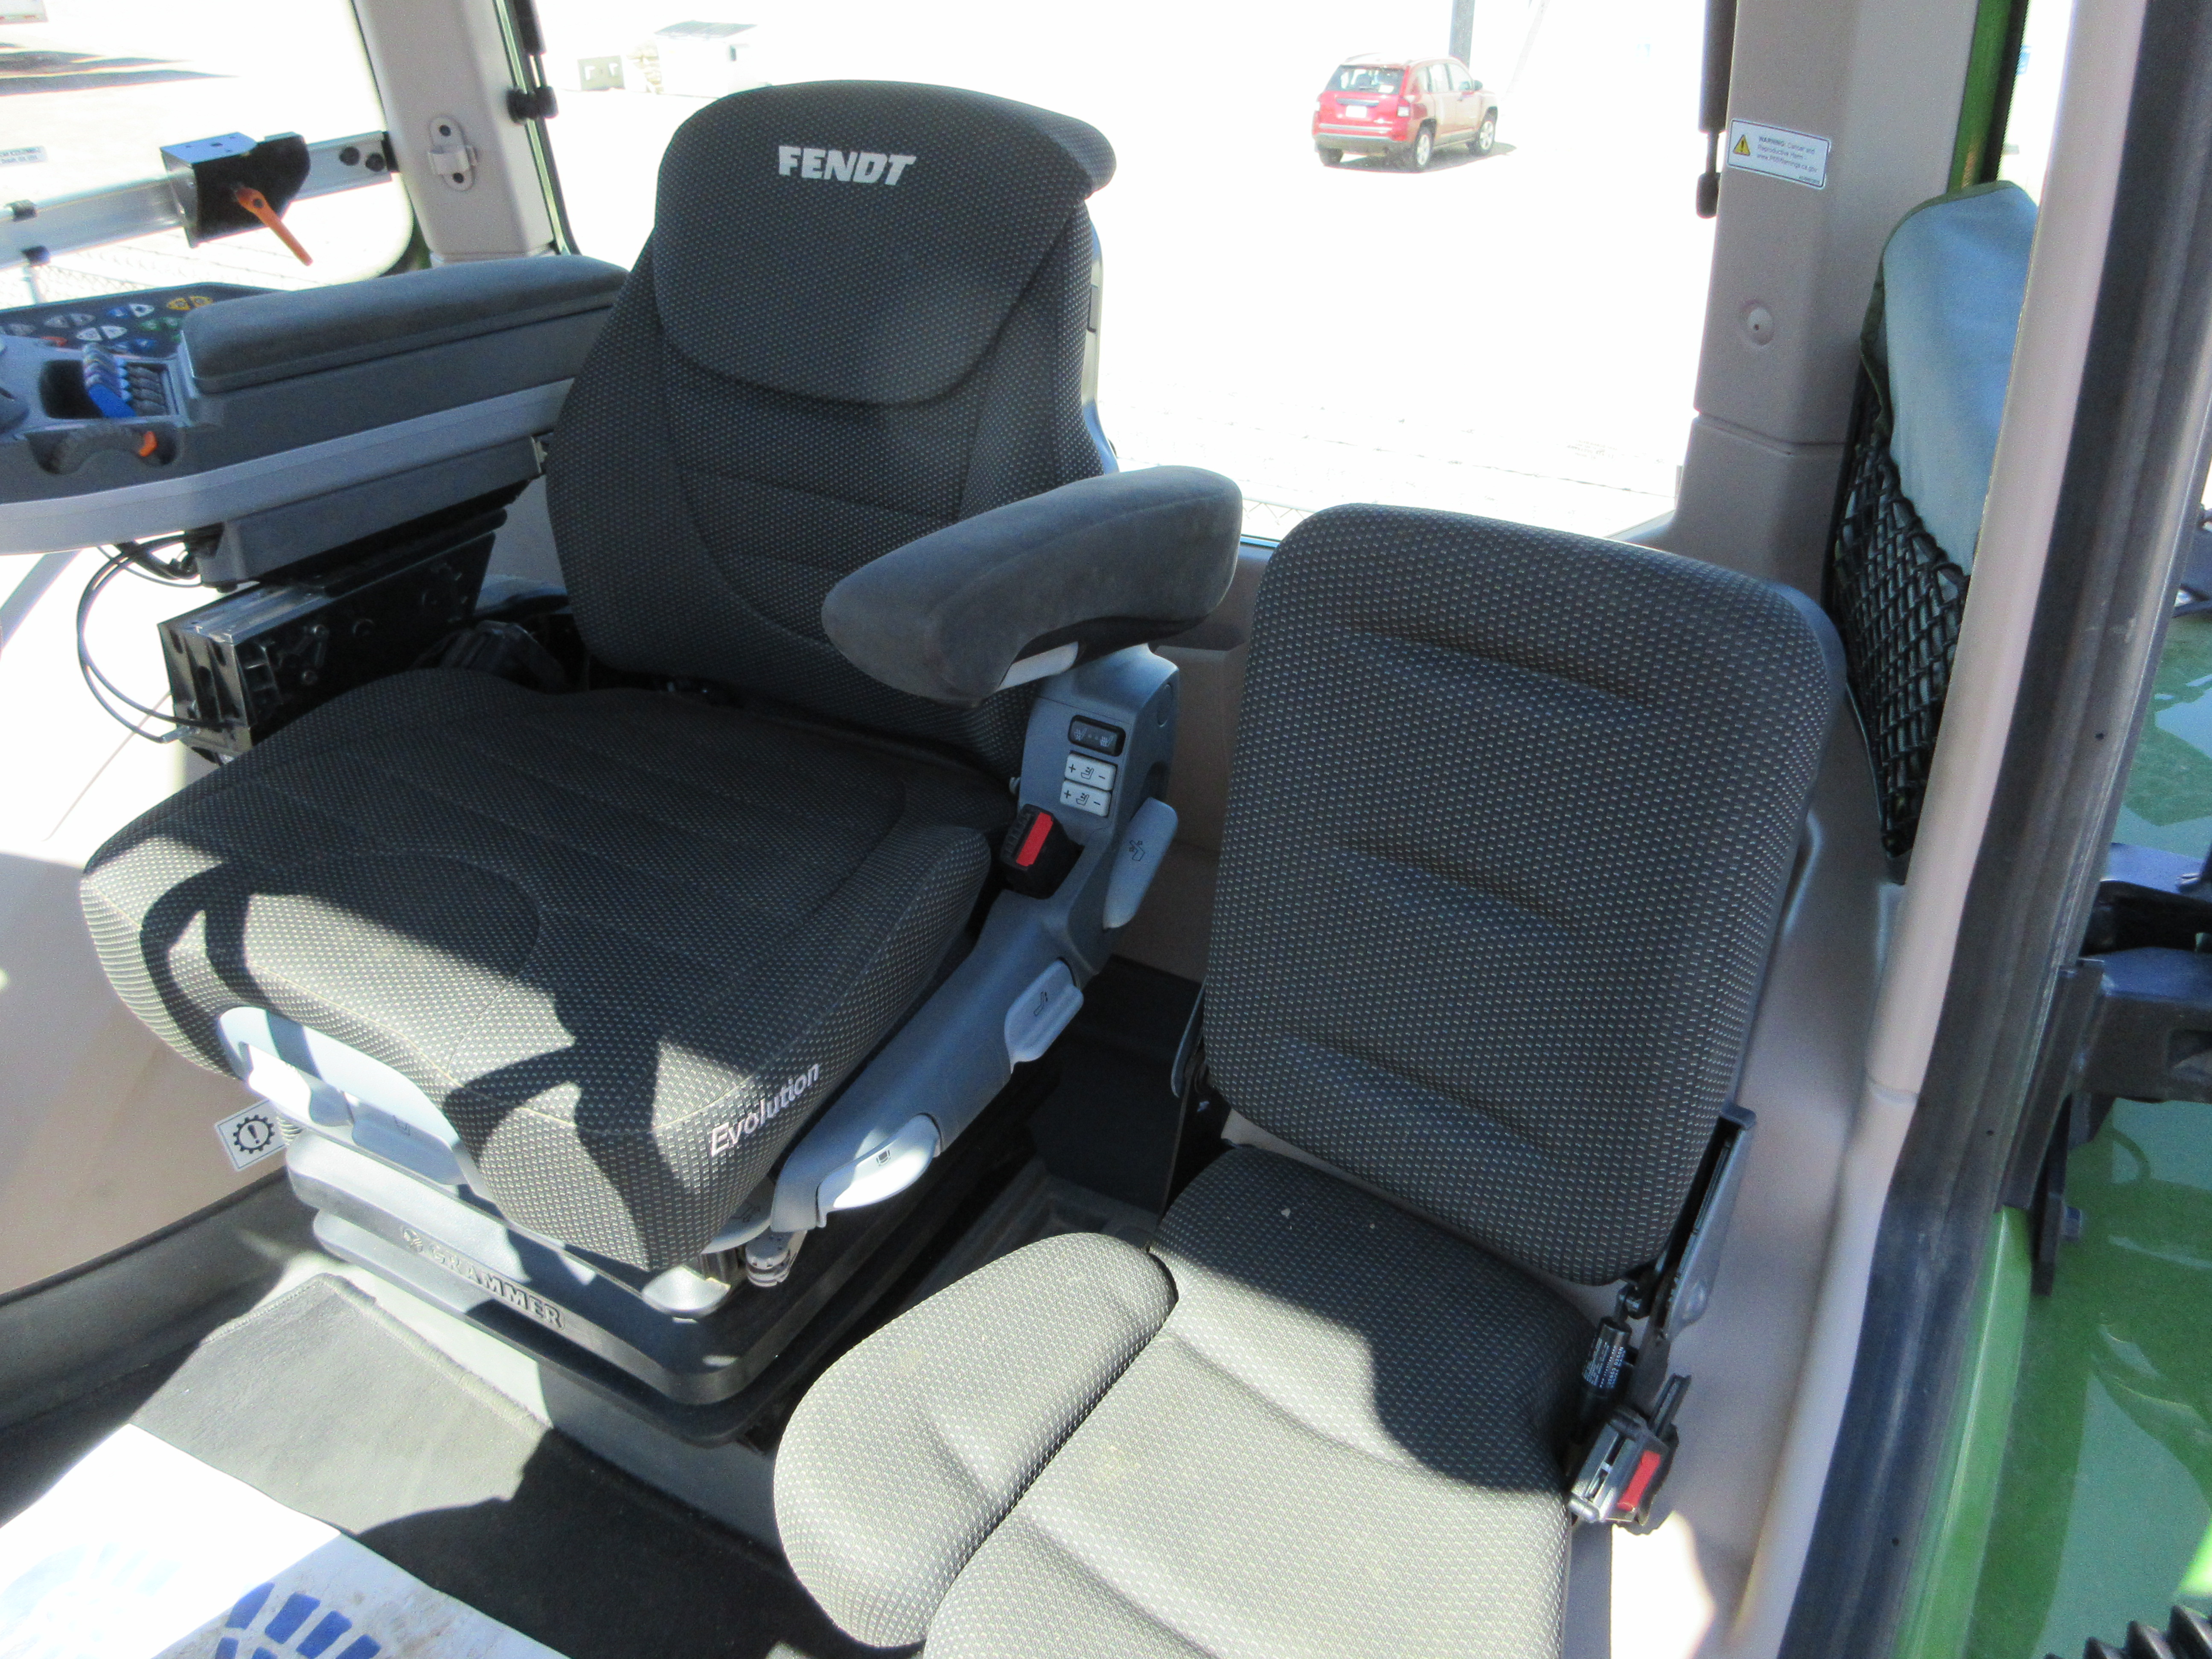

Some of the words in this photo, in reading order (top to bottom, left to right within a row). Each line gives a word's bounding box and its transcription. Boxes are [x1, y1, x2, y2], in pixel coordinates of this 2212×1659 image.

[778, 146, 917, 186] FENDT
[710, 1063, 820, 1157] Evolution
[428, 1243, 564, 1329] GRAMMER
